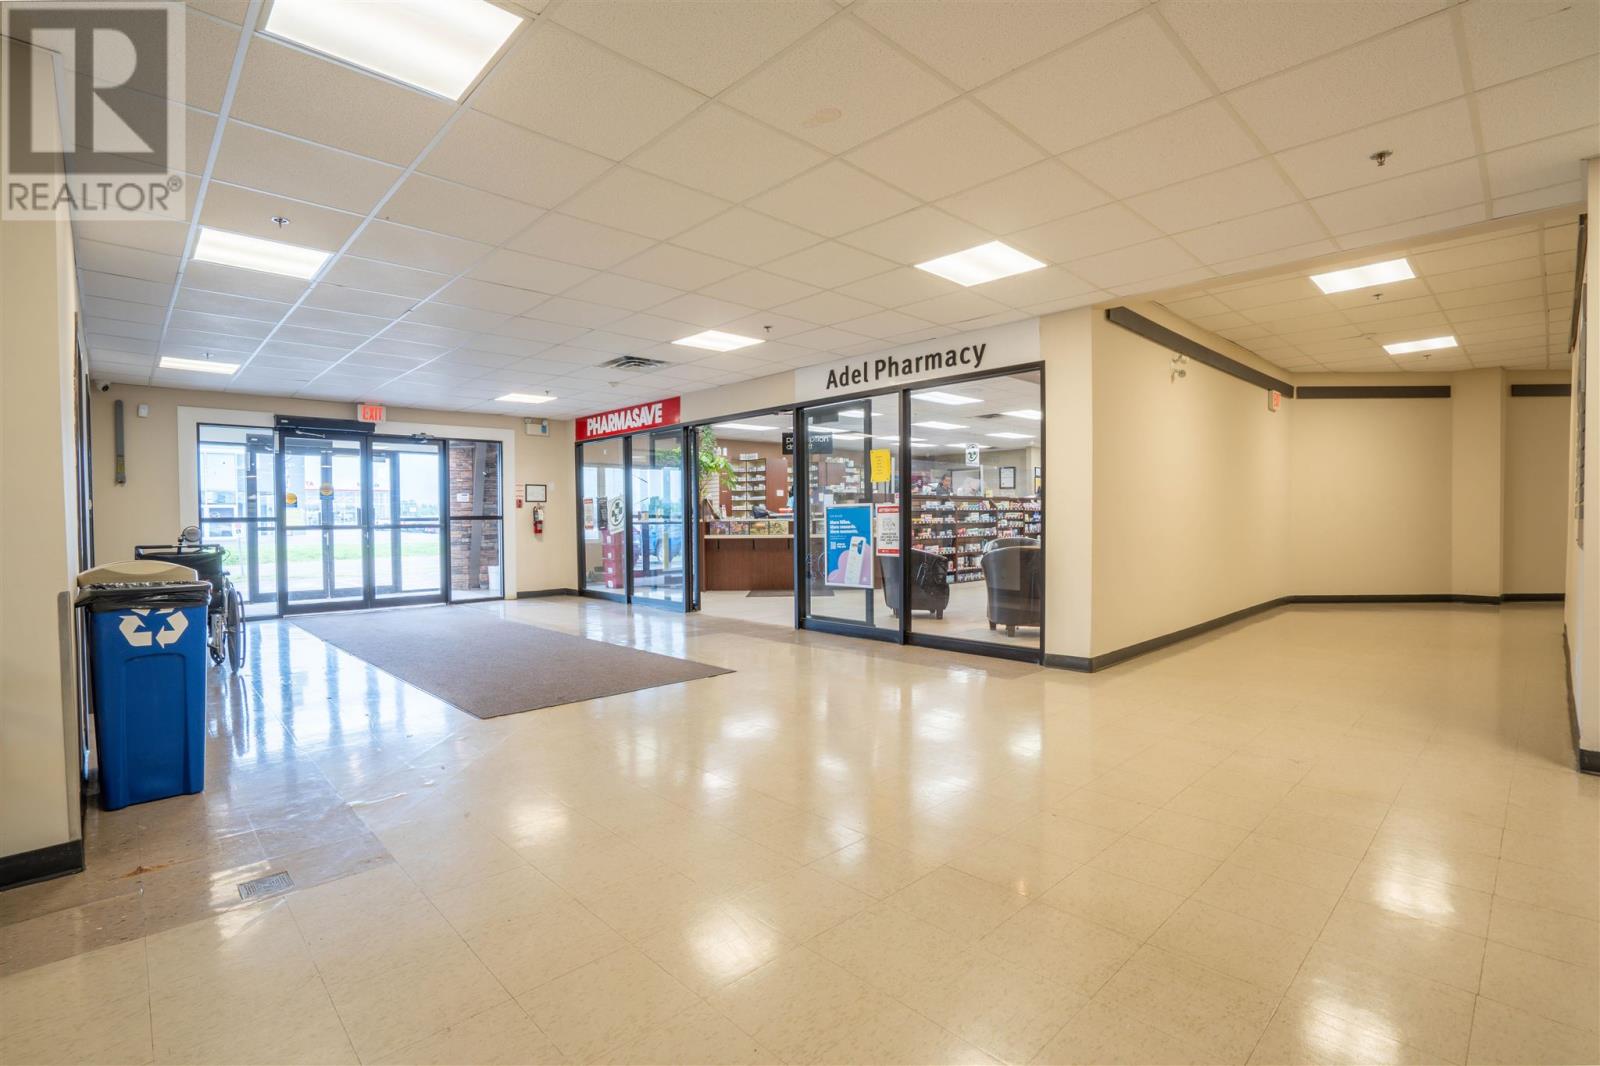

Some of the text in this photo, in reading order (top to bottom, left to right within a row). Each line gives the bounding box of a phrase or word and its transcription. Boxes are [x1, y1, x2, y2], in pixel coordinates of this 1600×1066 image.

[826, 343, 986, 390] Adel Pharmacy
[362, 405, 384, 421] EXIT
[587, 403, 663, 436] PHARMASAVE
